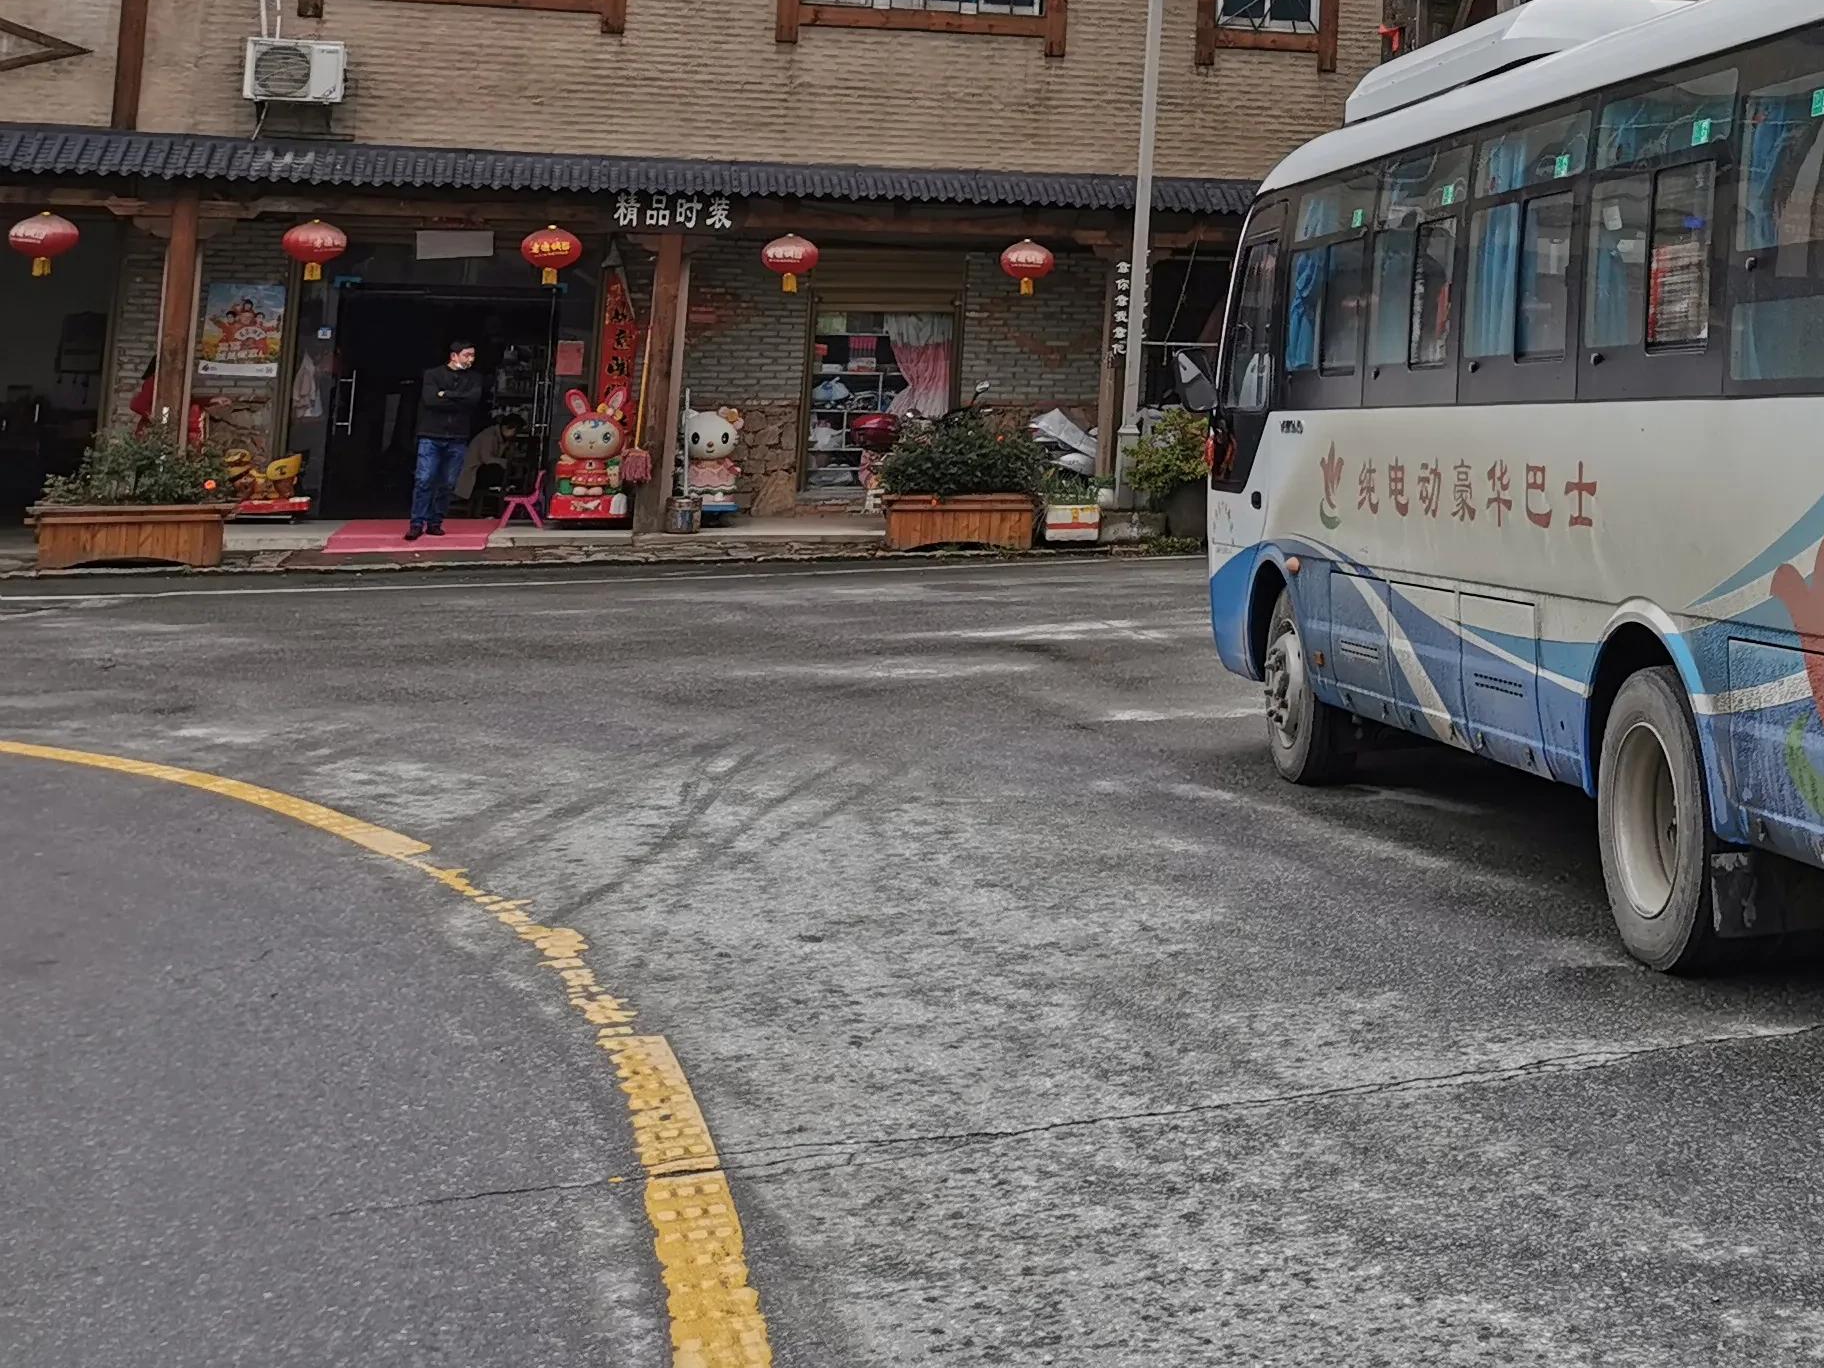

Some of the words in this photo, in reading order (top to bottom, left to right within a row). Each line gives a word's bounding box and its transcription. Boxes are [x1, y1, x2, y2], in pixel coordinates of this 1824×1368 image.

[613, 193, 732, 229] 精品时装
[1357, 456, 1598, 529] 纯电动豪华巴士
